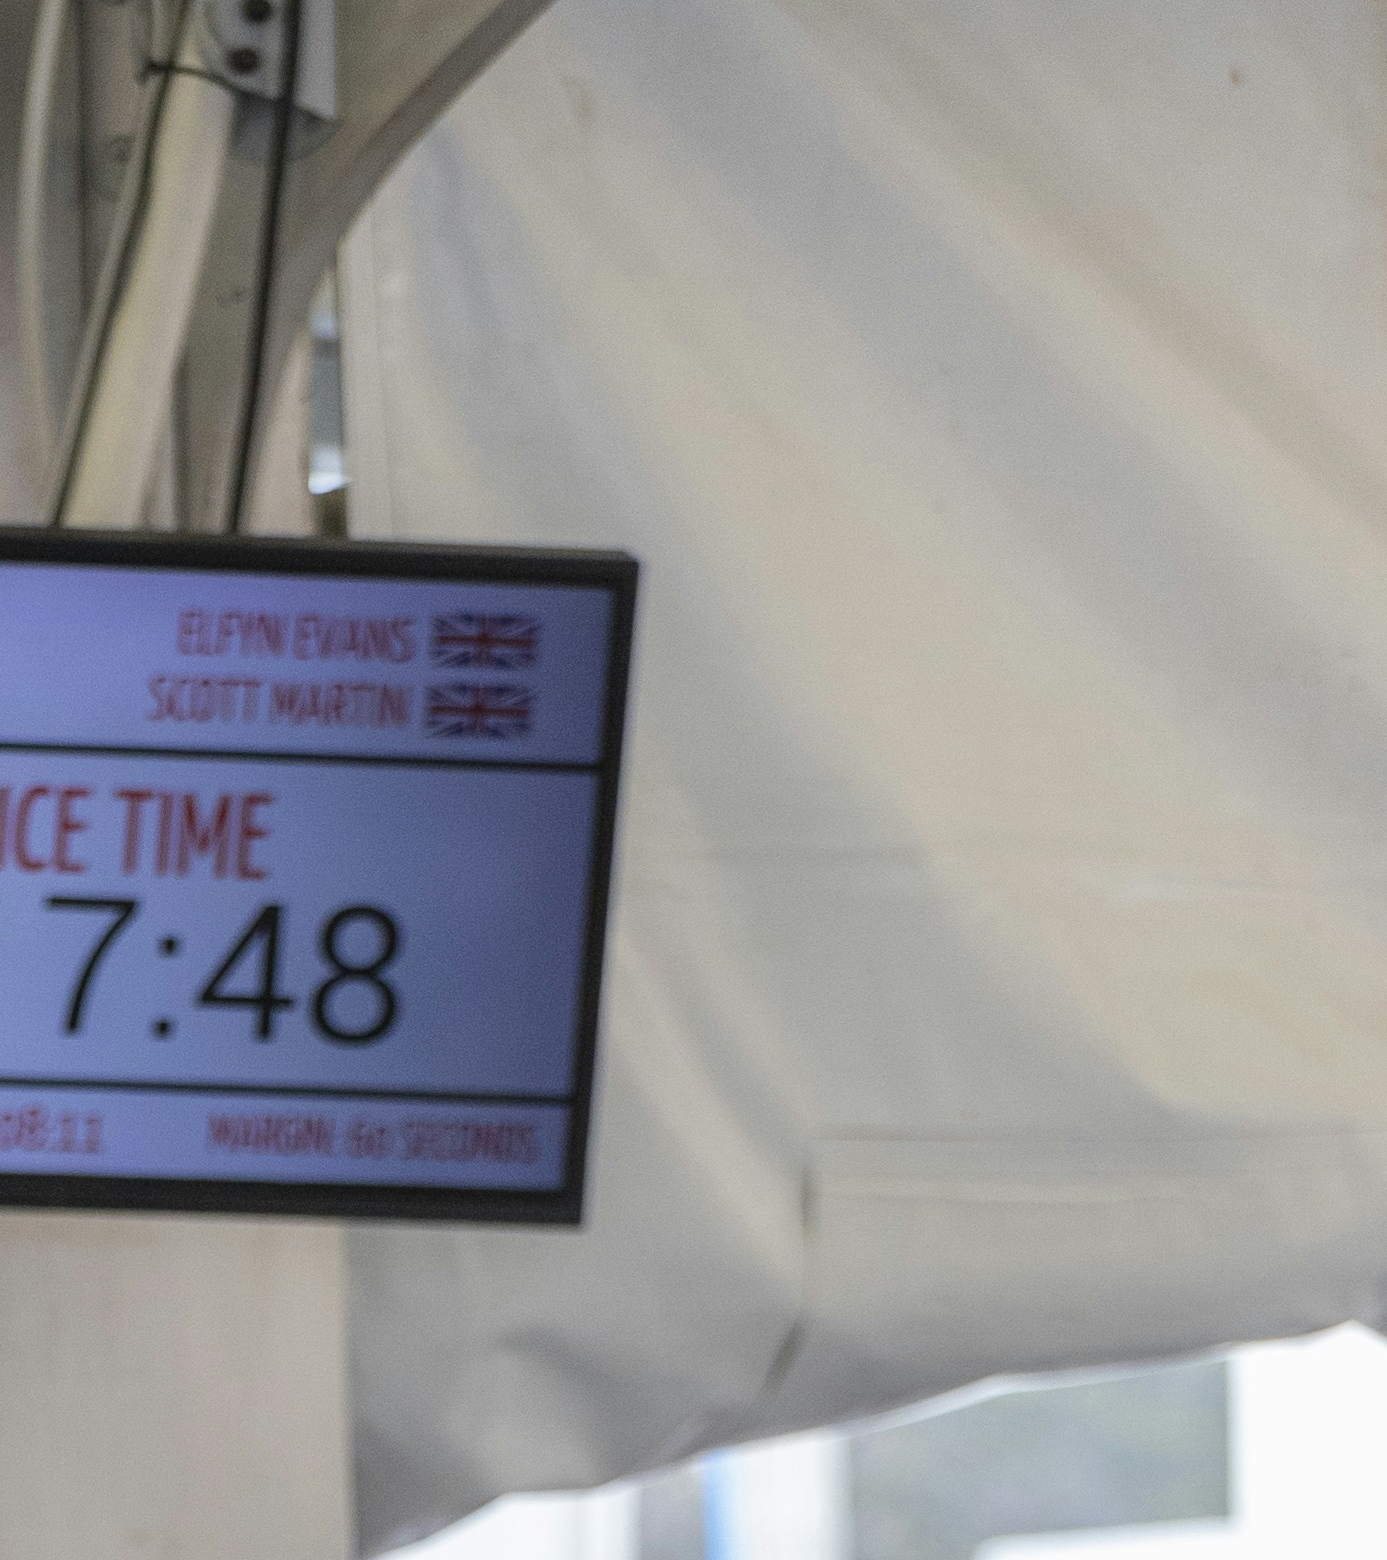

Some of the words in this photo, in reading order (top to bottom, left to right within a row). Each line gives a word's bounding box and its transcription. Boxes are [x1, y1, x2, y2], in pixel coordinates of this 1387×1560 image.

[177, 610, 289, 661] ELFYN
[294, 614, 415, 665] EVANS
[146, 676, 260, 725] SCOTT
[267, 681, 412, 730] MARTIN
[115, 787, 273, 879] TIME
